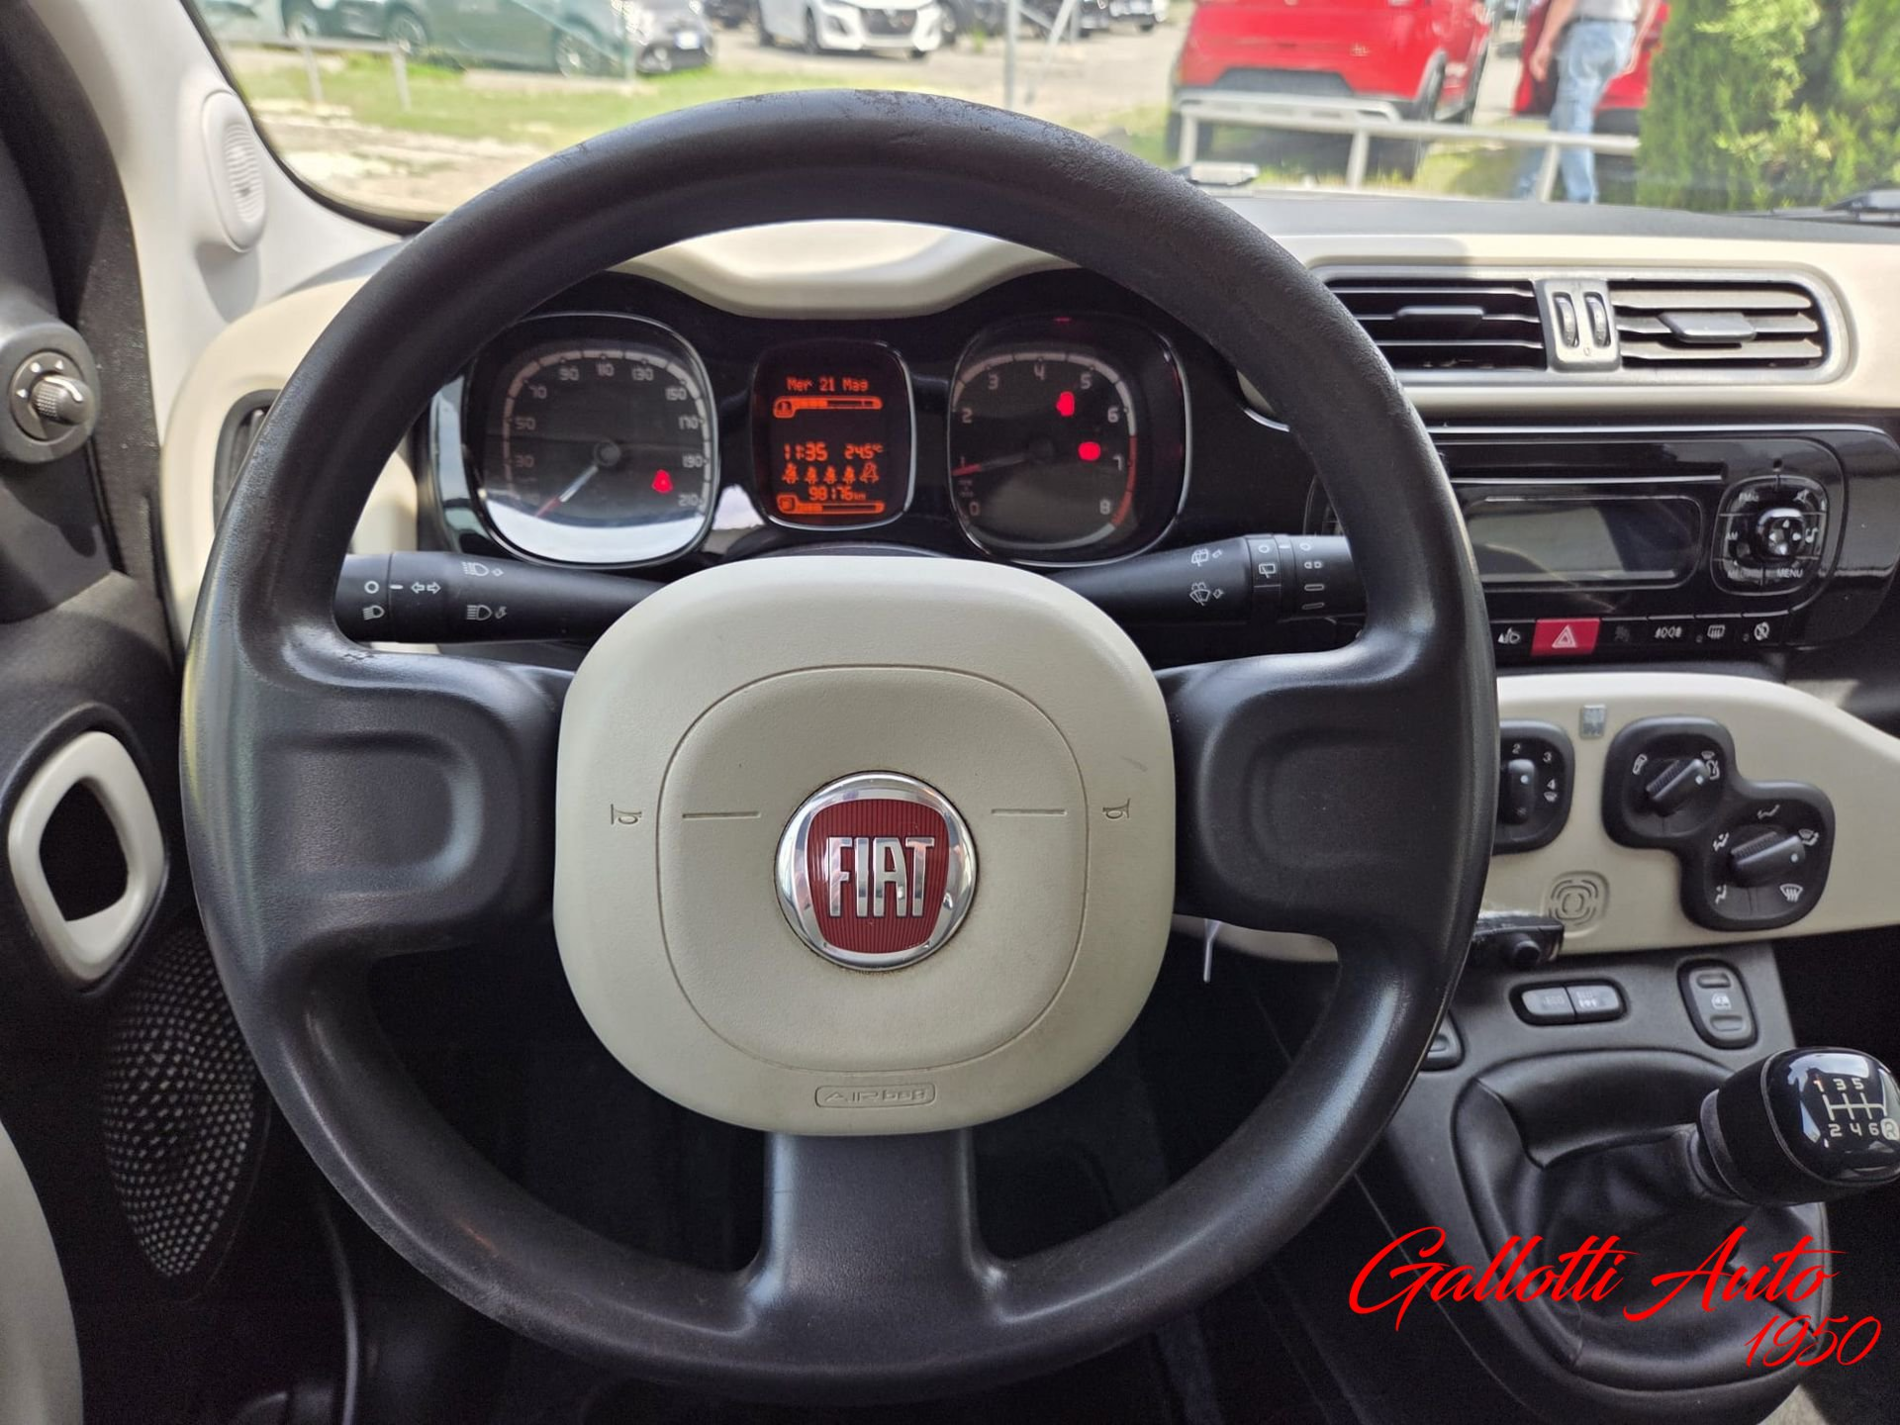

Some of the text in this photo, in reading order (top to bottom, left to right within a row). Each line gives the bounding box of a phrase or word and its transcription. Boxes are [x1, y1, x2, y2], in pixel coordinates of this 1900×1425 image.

[558, 366, 580, 382] 90
[631, 366, 654, 381] 130
[1033, 363, 1046, 381] 4
[819, 377, 835, 391] 21
[987, 373, 1000, 390] 3
[1079, 373, 1093, 390] 5
[665, 387, 688, 401] 150
[678, 414, 699, 430] 170
[961, 407, 974, 424] 2
[1106, 406, 1120, 423] 6
[514, 416, 536, 431] 50
[784, 442, 828, 461] 11:35
[682, 455, 703, 469] 190
[1112, 455, 1124, 472] 7
[1099, 500, 1112, 516] 8
[1776, 568, 1804, 579] MENU
[1511, 743, 1521, 755] 2
[1542, 751, 1553, 763] 3
[1546, 779, 1556, 791] 4
[826, 836, 936, 918] FIAT
[1832, 1077, 1848, 1091] 3
[1850, 1076, 1865, 1091] 5
[1827, 1123, 1843, 1138] 2
[1848, 1122, 1863, 1137] 4
[1867, 1122, 1880, 1136] 6
